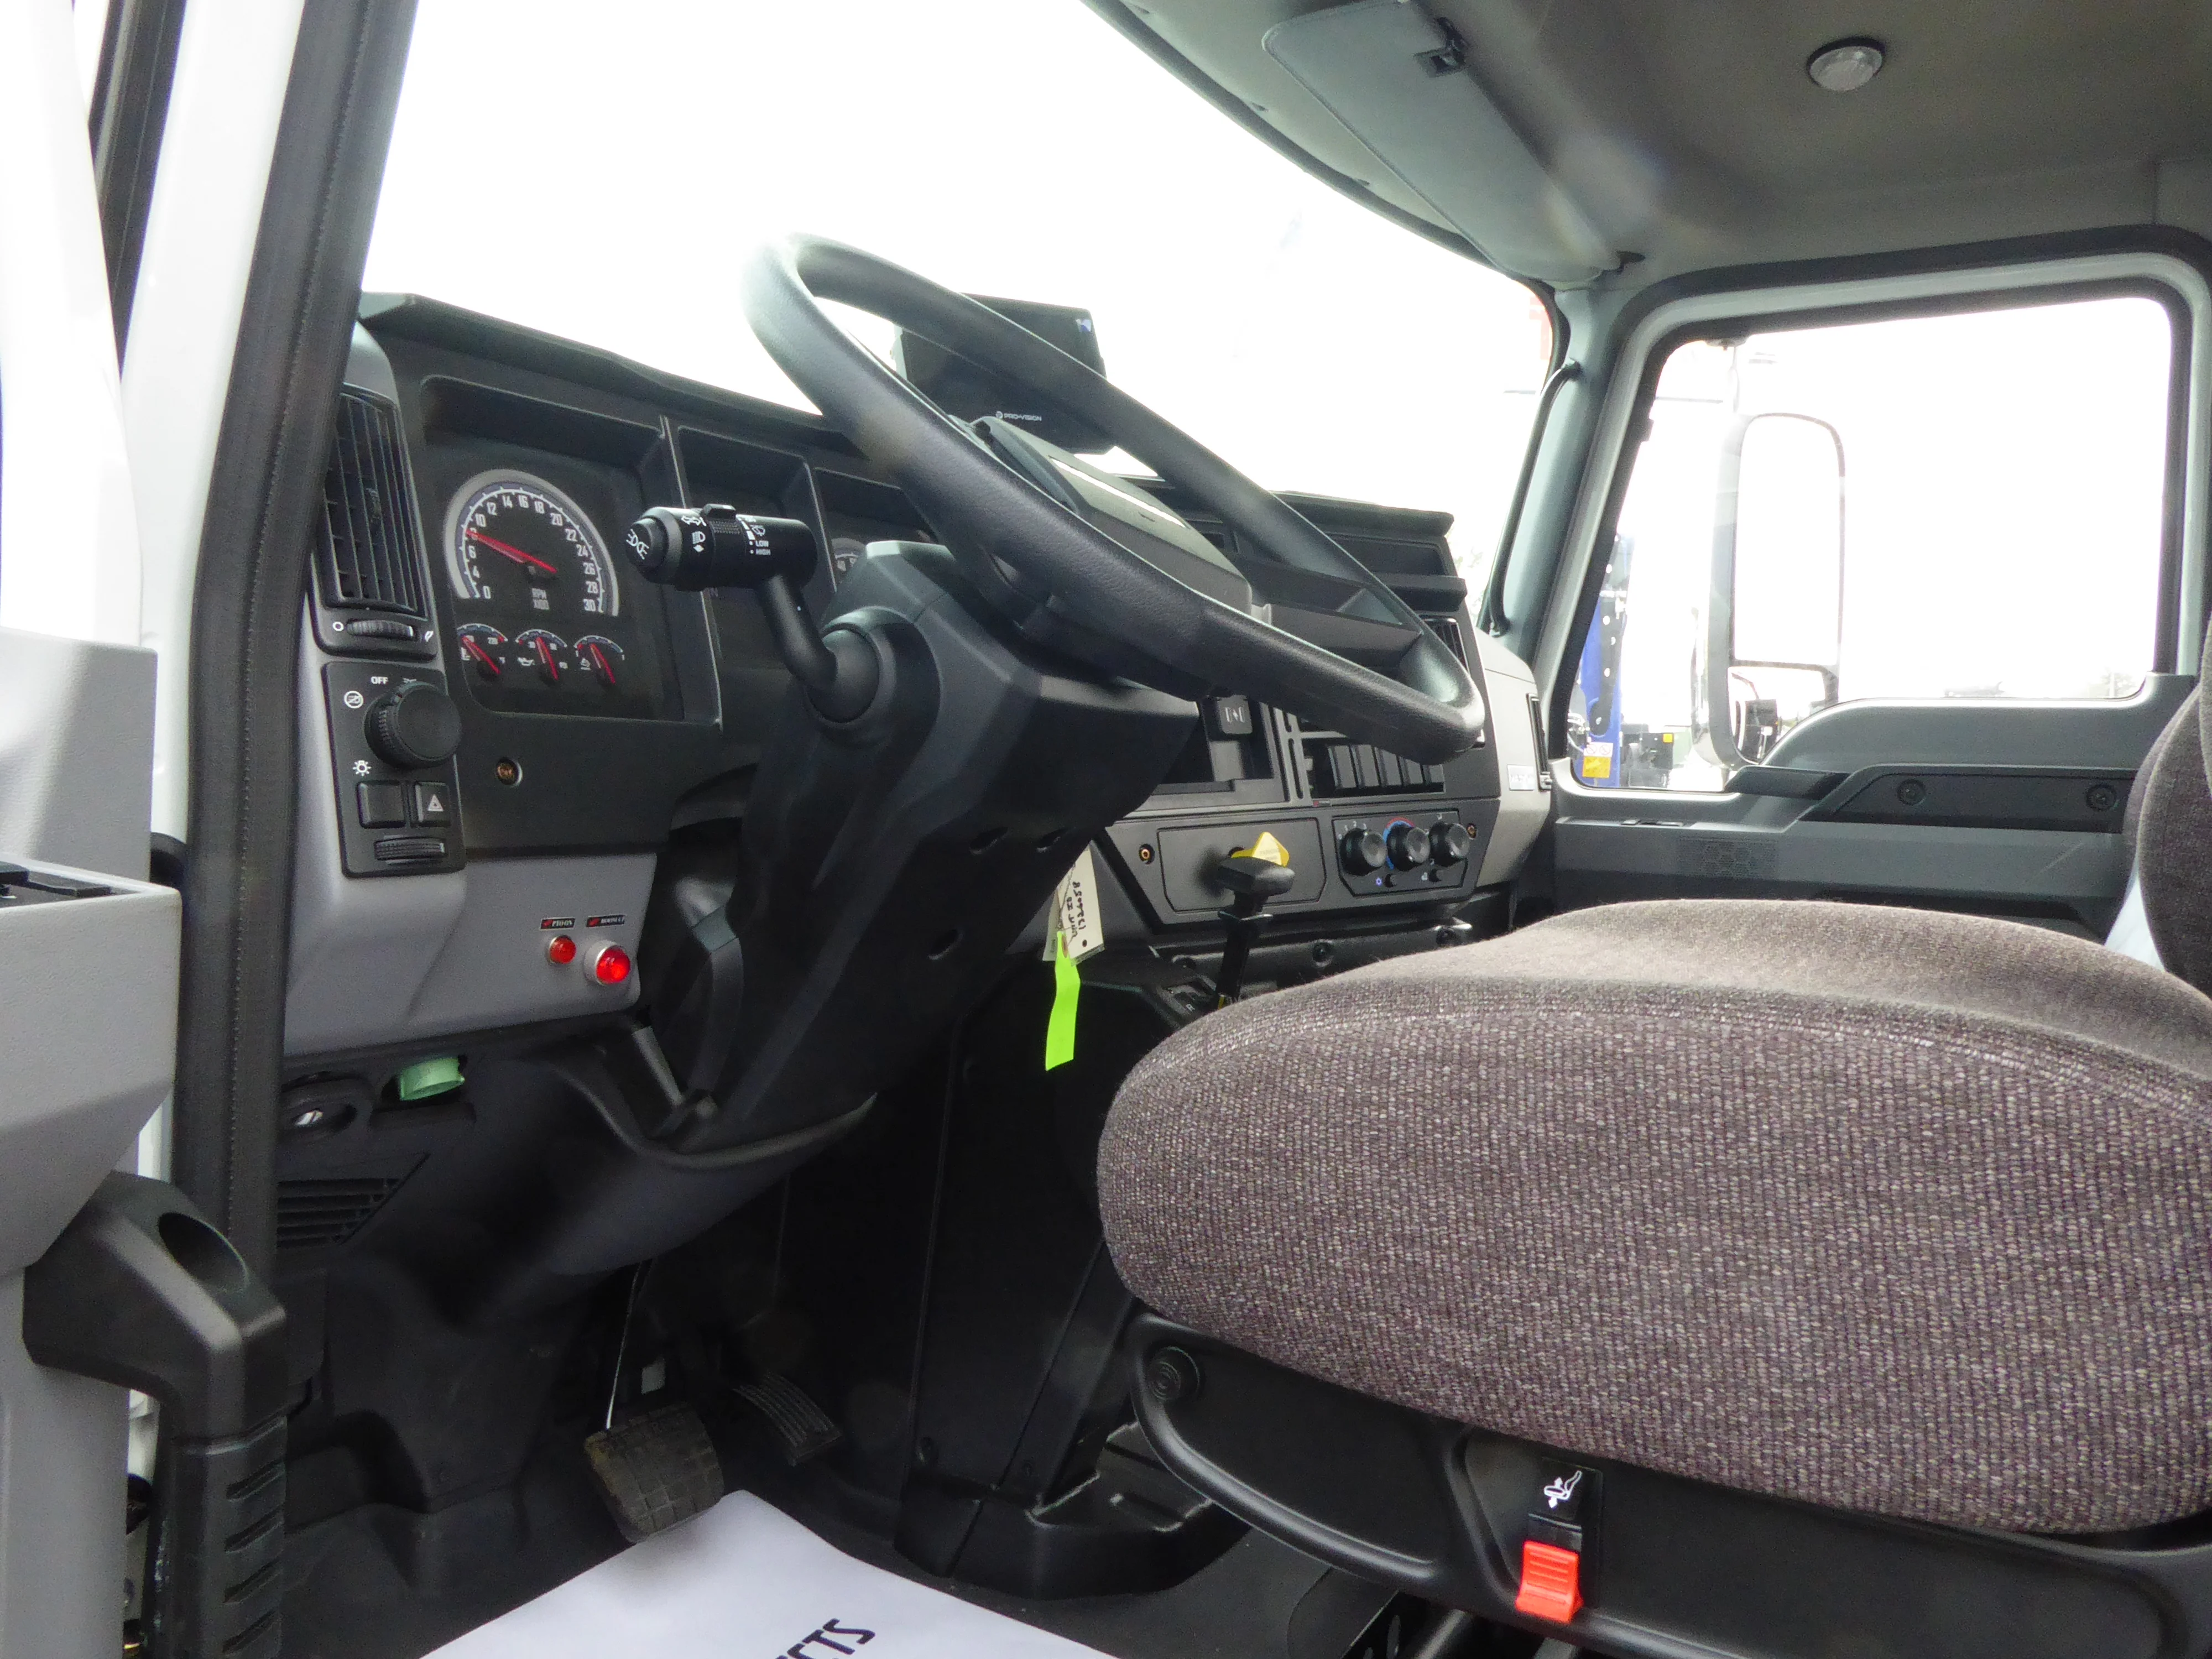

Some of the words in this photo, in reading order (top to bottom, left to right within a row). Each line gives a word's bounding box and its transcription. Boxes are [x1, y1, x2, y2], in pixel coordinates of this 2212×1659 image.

[502, 495, 513, 508] 14
[518, 495, 529, 508] 16
[534, 501, 545, 514] 18
[487, 502, 497, 515] 12
[474, 513, 486, 527] 10
[550, 513, 563, 526] 20
[565, 528, 577, 542] 22
[468, 545, 477, 559] 6
[576, 544, 588, 557] 24
[473, 565, 480, 578] 4
[583, 562, 596, 575] 26
[483, 586, 491, 599] 0
[585, 581, 598, 594] 28
[583, 598, 596, 612] 30
[371, 676, 388, 685] OFF
